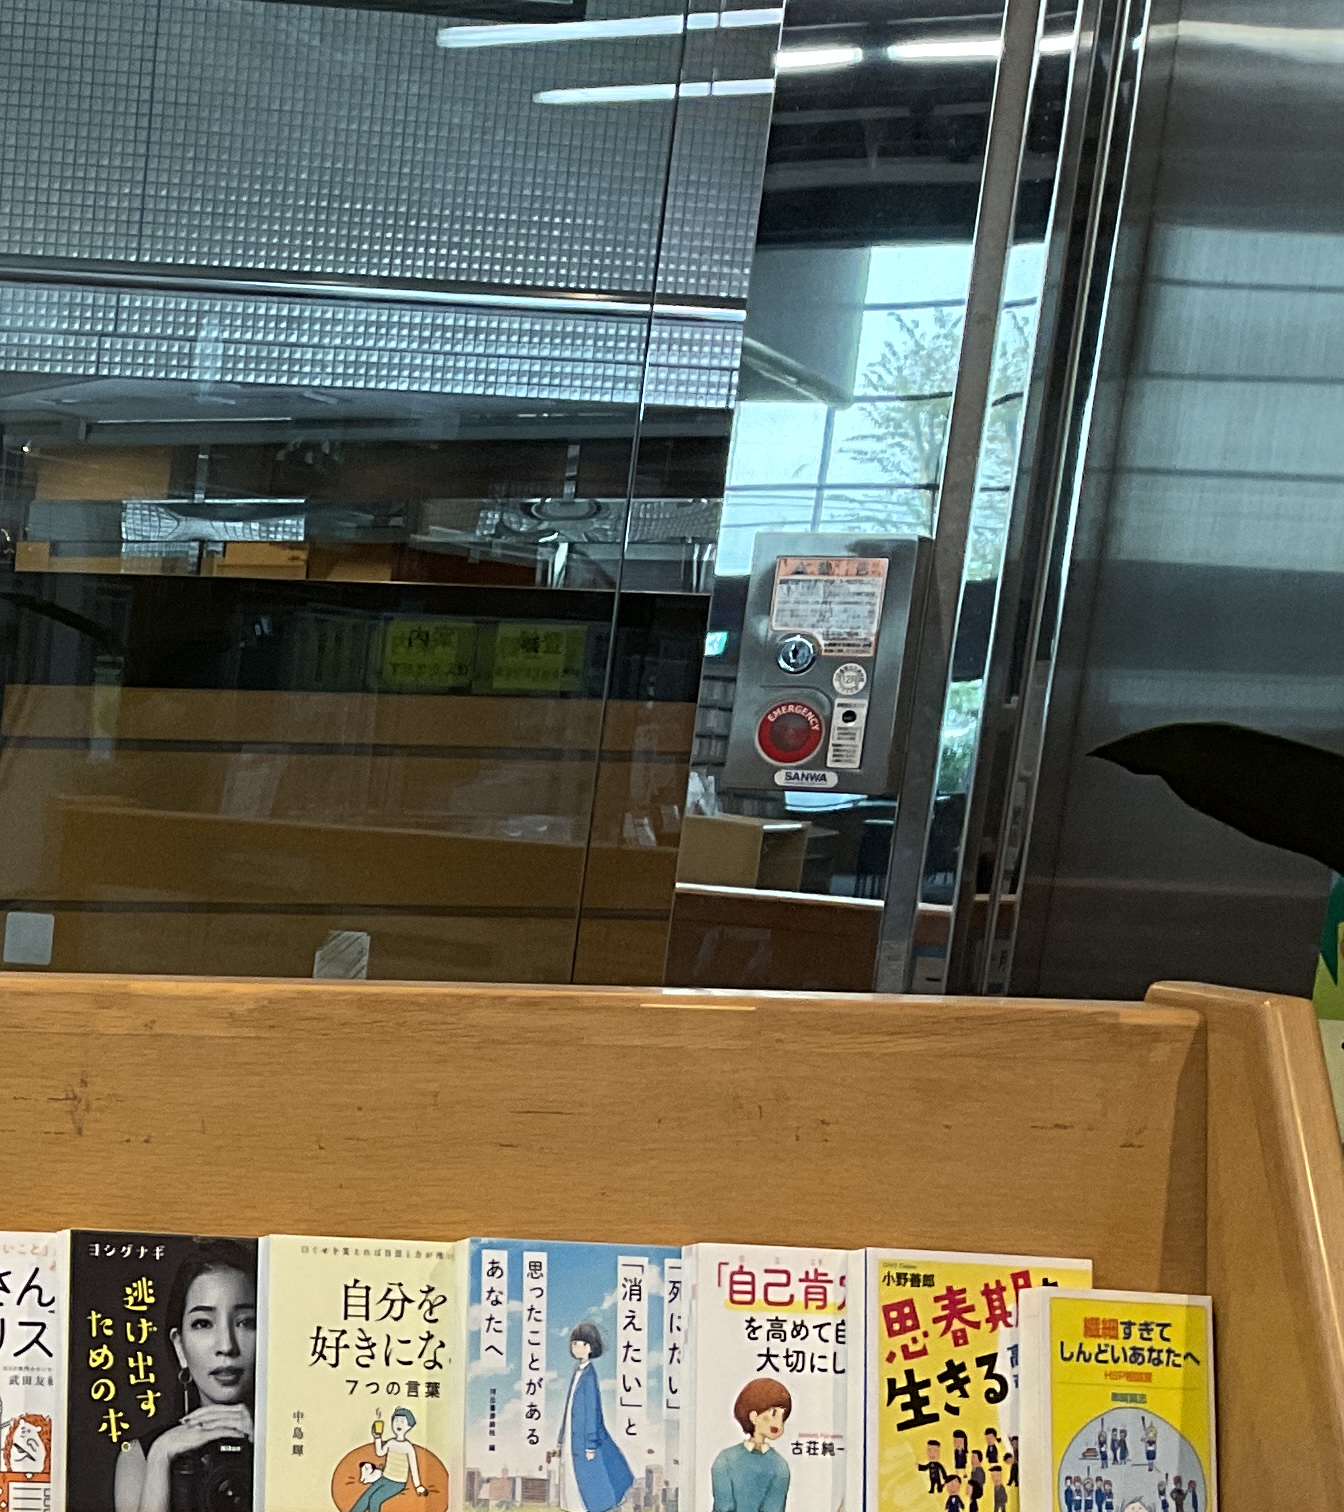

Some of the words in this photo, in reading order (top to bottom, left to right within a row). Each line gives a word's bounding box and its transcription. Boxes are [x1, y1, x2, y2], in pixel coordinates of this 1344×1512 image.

[767, 704, 819, 731] EMERGENCY
[784, 770, 828, 784] SANWA
[343, 1278, 448, 1324] 自分を
[484, 1258, 505, 1356] あなたへ
[86, 1310, 132, 1453] ための本。
[123, 1276, 162, 1420] 逃げ出す
[525, 1260, 546, 1446] 思ったことがある
[620, 1262, 647, 1437] 「消えたい」と
[1060, 1340, 1201, 1367] しんどいあなたへ
[345, 1379, 441, 1398] 7つの言葉
[886, 1352, 1009, 1431] 生きる
